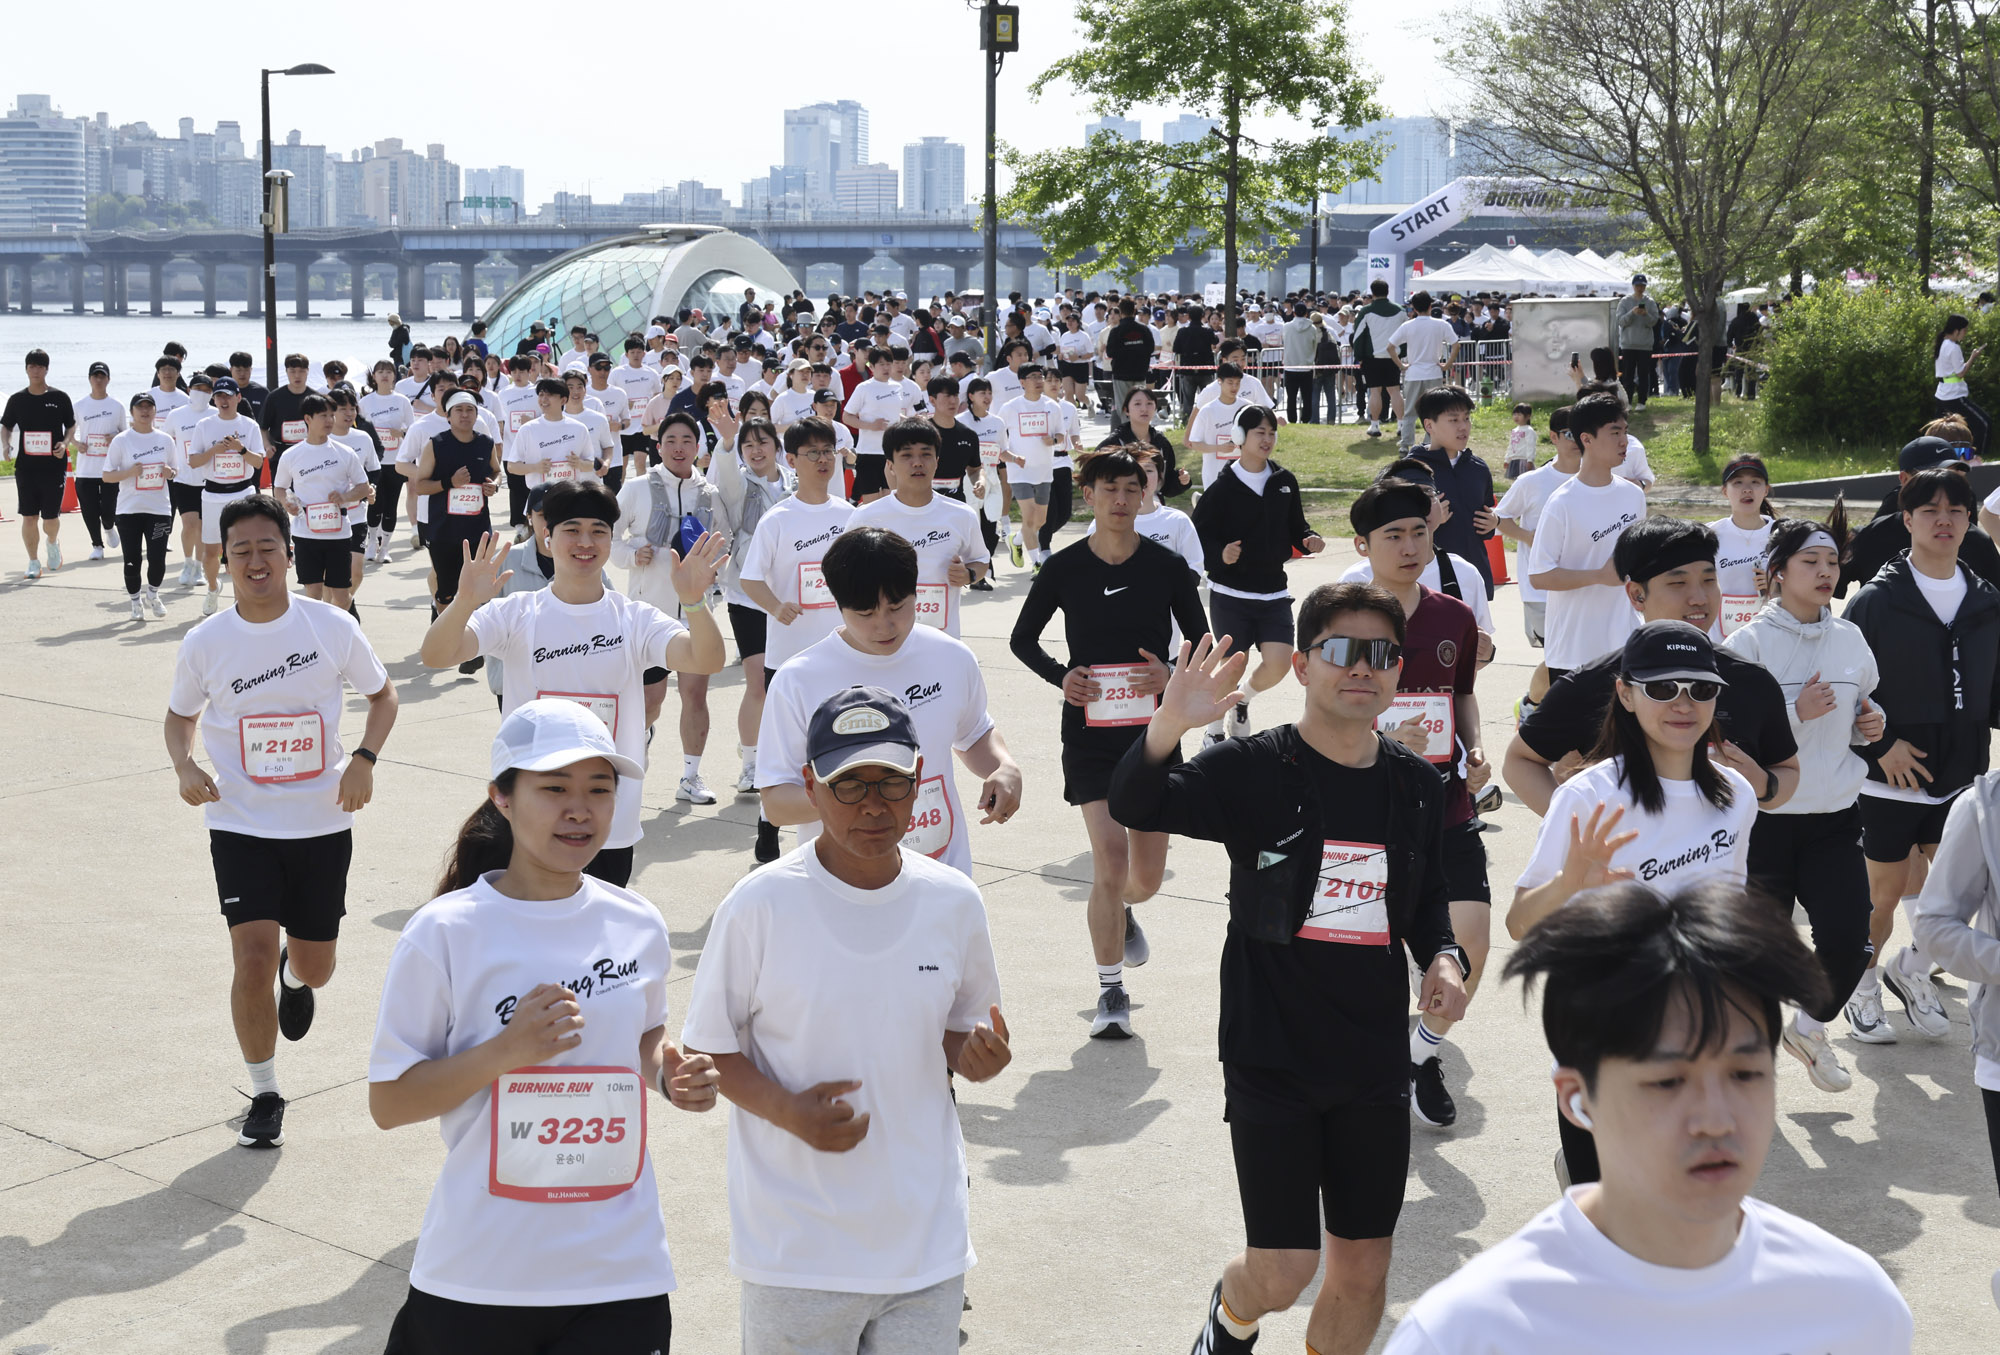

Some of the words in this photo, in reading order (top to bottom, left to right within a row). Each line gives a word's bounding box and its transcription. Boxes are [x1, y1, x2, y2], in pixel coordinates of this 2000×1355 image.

[1391, 196, 1450, 241] START
[84, 413, 101, 421] Burning
[181, 424, 196, 432] Burni
[539, 439, 561, 449] Burning
[562, 434, 575, 442] Run
[133, 450, 153, 460] Burning
[299, 463, 324, 477] Burning
[324, 460, 338, 468] Run
[460, 494, 480, 502] 2221
[318, 512, 338, 520] 1962
[1591, 521, 1622, 542] Burning
[1621, 512, 1637, 528] Run
[795, 533, 830, 551] Burning
[927, 530, 950, 544] Run
[815, 579, 828, 588] 24
[533, 643, 590, 663] Burning
[591, 634, 624, 650] Run
[1667, 644, 1697, 652] KIPRUN
[231, 669, 286, 694] Burning
[286, 651, 318, 671] Run
[905, 682, 942, 705] Run
[1953, 668, 1963, 709] AIR
[1385, 722, 1395, 731] M
[251, 743, 262, 751] M
[265, 737, 314, 753] 2128
[924, 786, 940, 795] 10km
[1276, 828, 1304, 847] SALOMON
[1322, 851, 1349, 860] RNING
[1351, 853, 1370, 862] RUN
[1639, 844, 1711, 880] Burning
[1324, 878, 1388, 900] 2107
[593, 958, 638, 986] Run
[508, 1082, 565, 1093] BURNING
[567, 1082, 594, 1093] RUN
[606, 1083, 634, 1092] 10km
[511, 1122, 533, 1139] W
[538, 1117, 626, 1145] 3235
[556, 1153, 585, 1165] 윤송이
